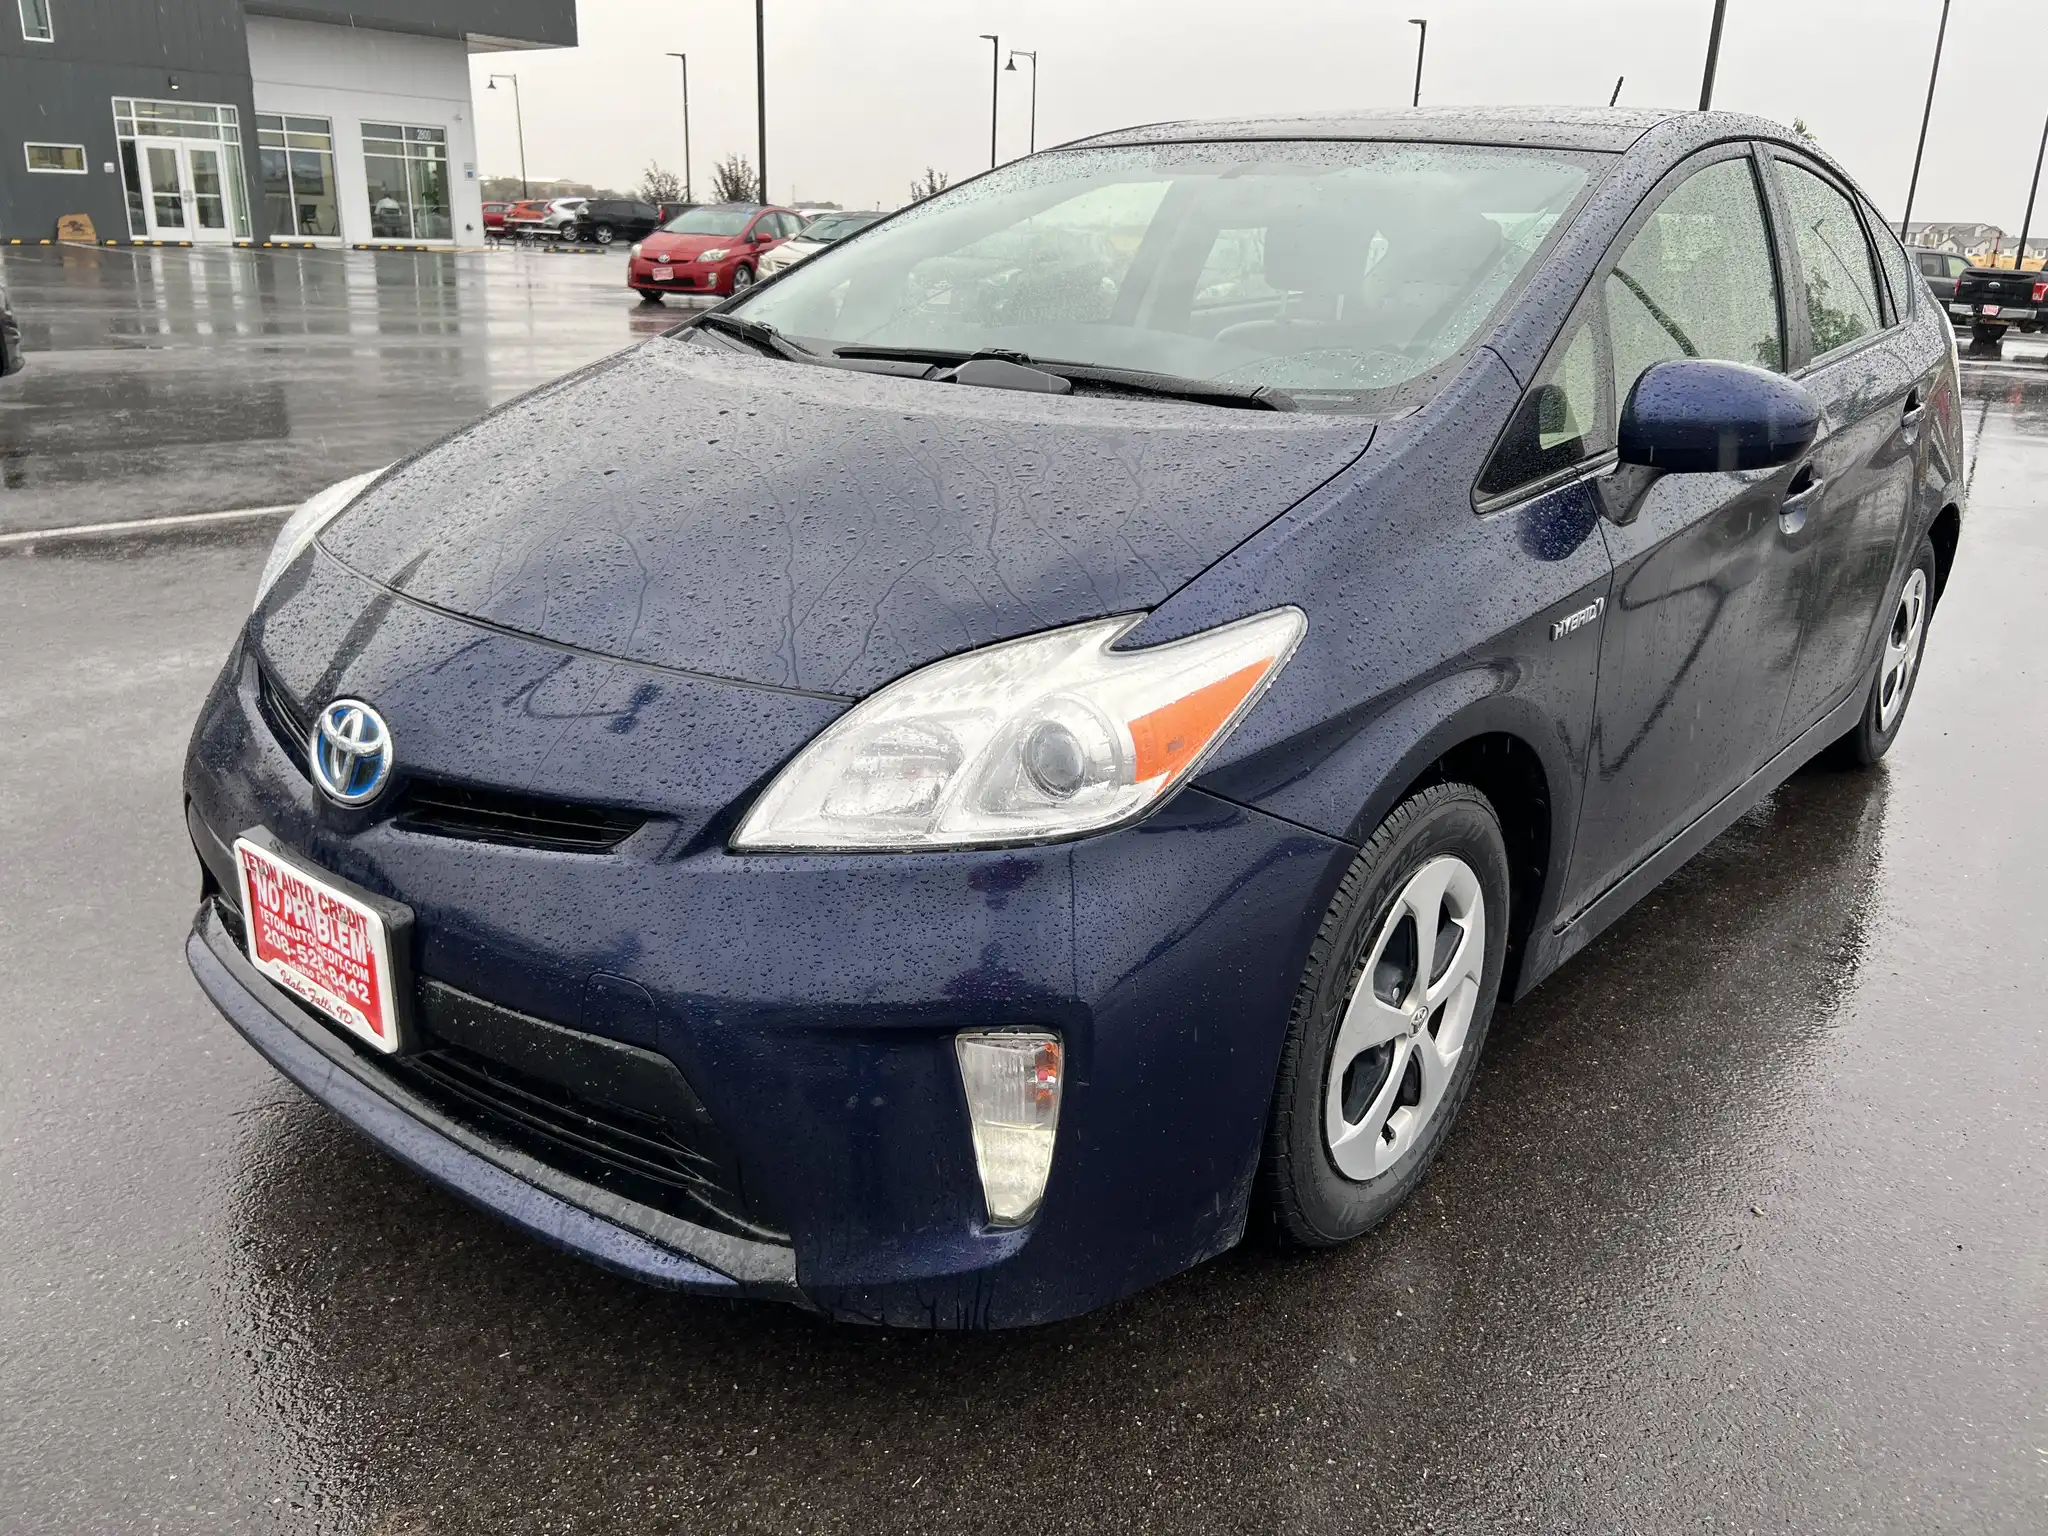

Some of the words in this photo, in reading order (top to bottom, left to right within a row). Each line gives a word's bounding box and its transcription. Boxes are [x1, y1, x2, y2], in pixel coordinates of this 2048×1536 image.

[1552, 602, 1600, 641] HYBRID
[239, 847, 279, 887] TETON
[282, 871, 315, 907] AUTO
[318, 892, 368, 937] CREDIT
